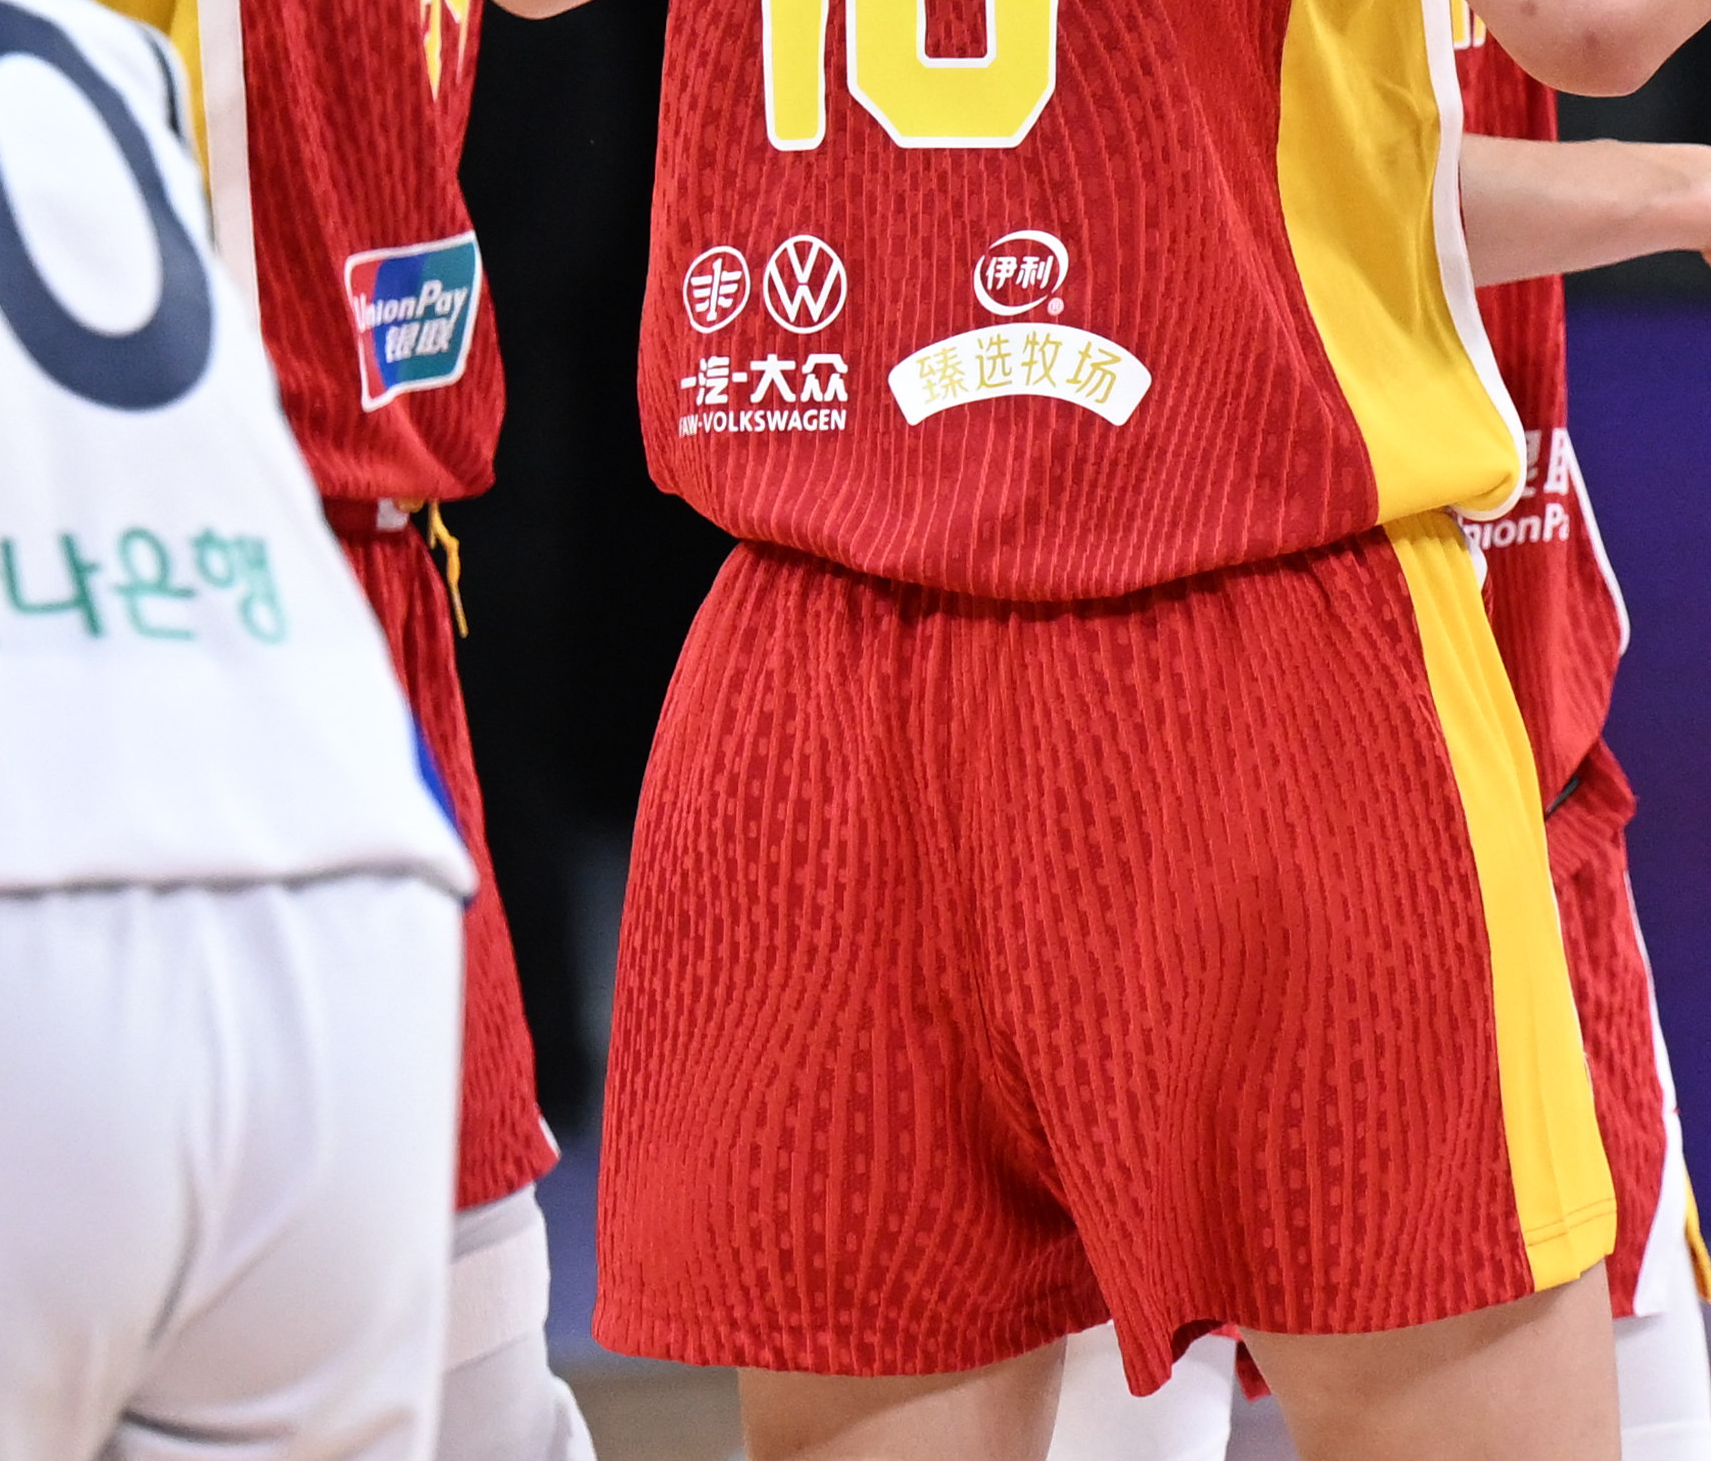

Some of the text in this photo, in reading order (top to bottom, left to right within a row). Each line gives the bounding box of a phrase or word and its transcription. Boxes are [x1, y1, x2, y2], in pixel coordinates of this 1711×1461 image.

[985, 254, 1054, 291] 伊利
[352, 279, 469, 334] UnionPay
[915, 329, 1125, 405] 臻选牧场
